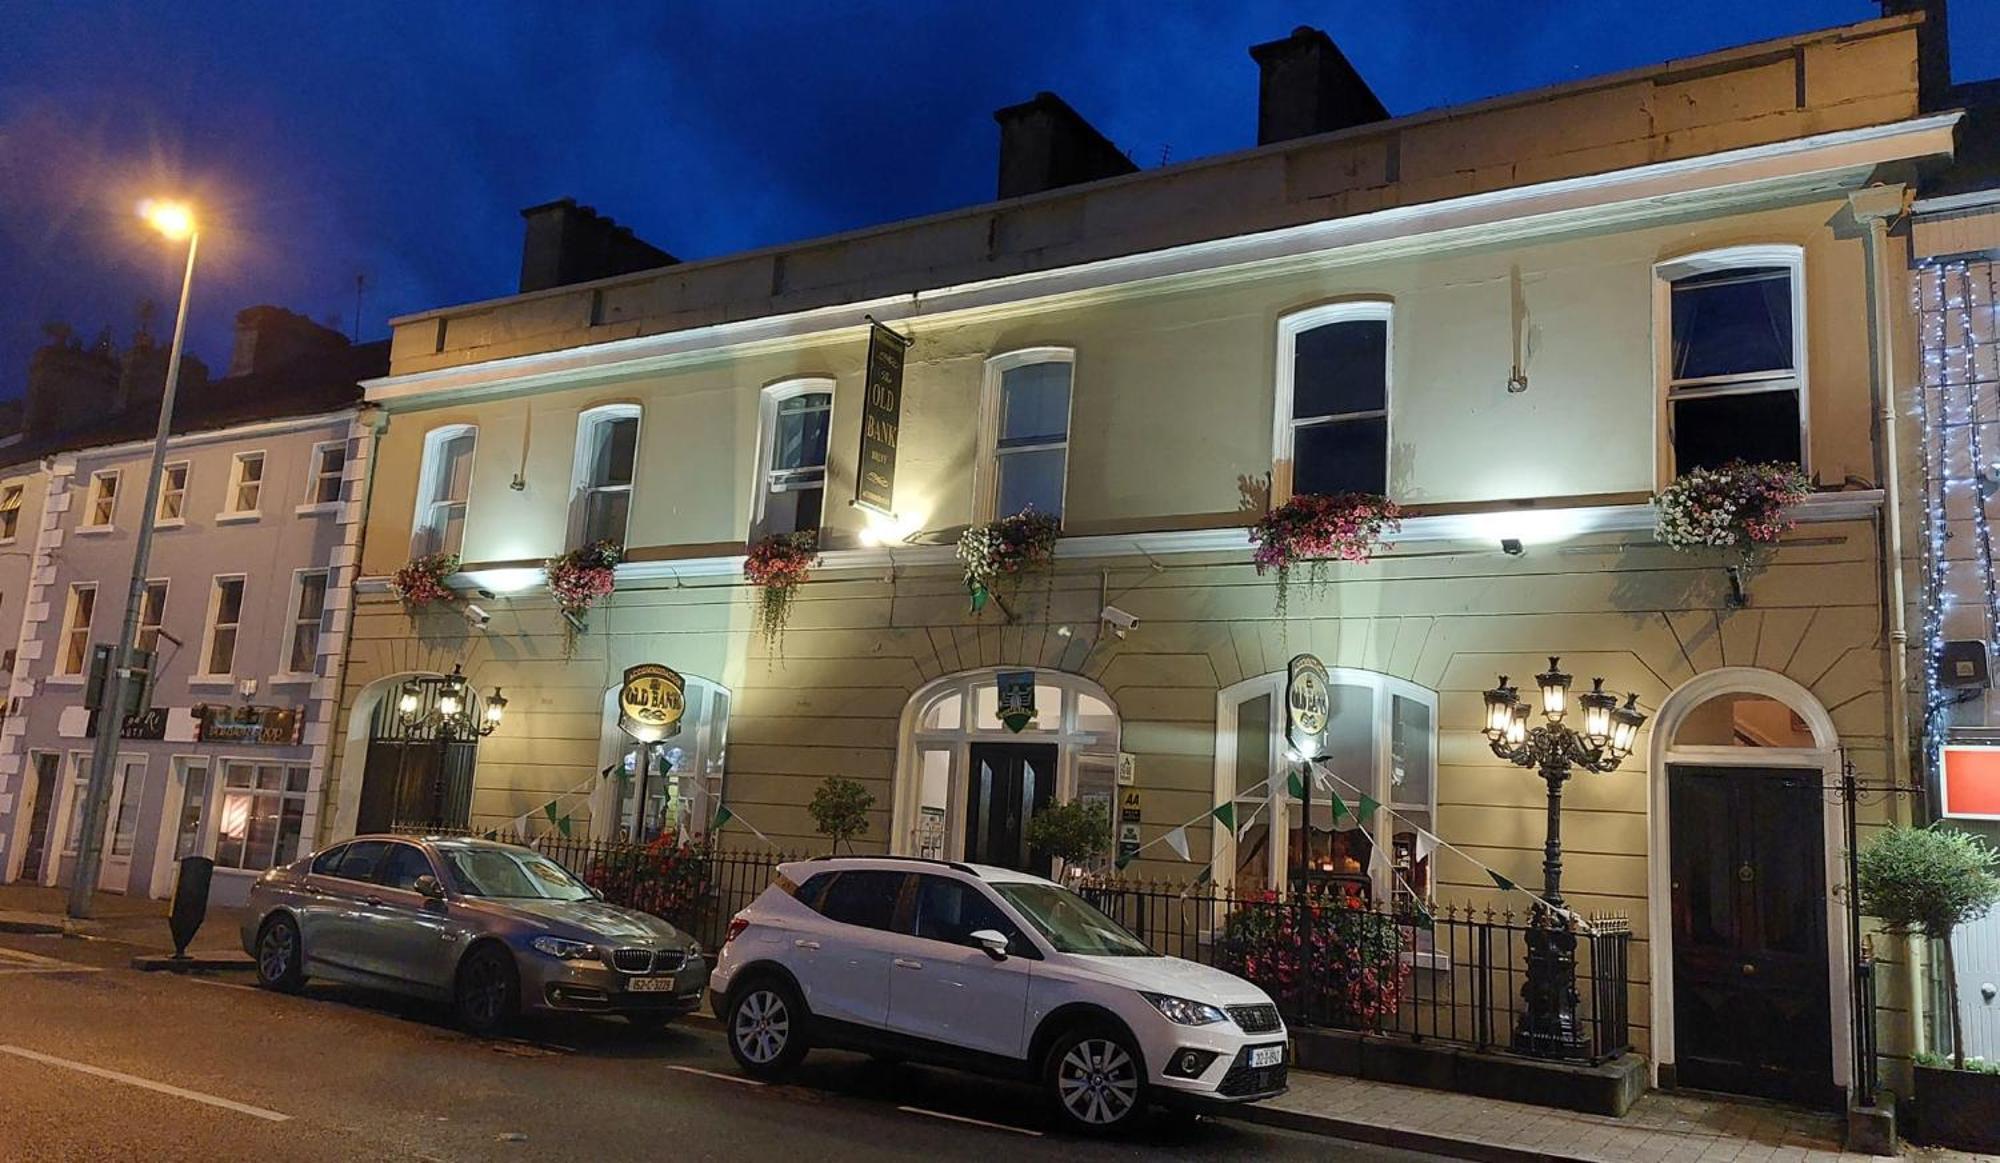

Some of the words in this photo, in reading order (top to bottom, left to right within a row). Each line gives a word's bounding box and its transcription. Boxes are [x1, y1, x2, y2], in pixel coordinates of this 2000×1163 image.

[872, 383, 894, 413] OLD
[866, 415, 897, 449] BANK
[625, 686, 649, 706] OLD
[651, 688, 682, 711] BANK
[1291, 687, 1307, 710] OLD
[1125, 793, 1140, 806] AA
